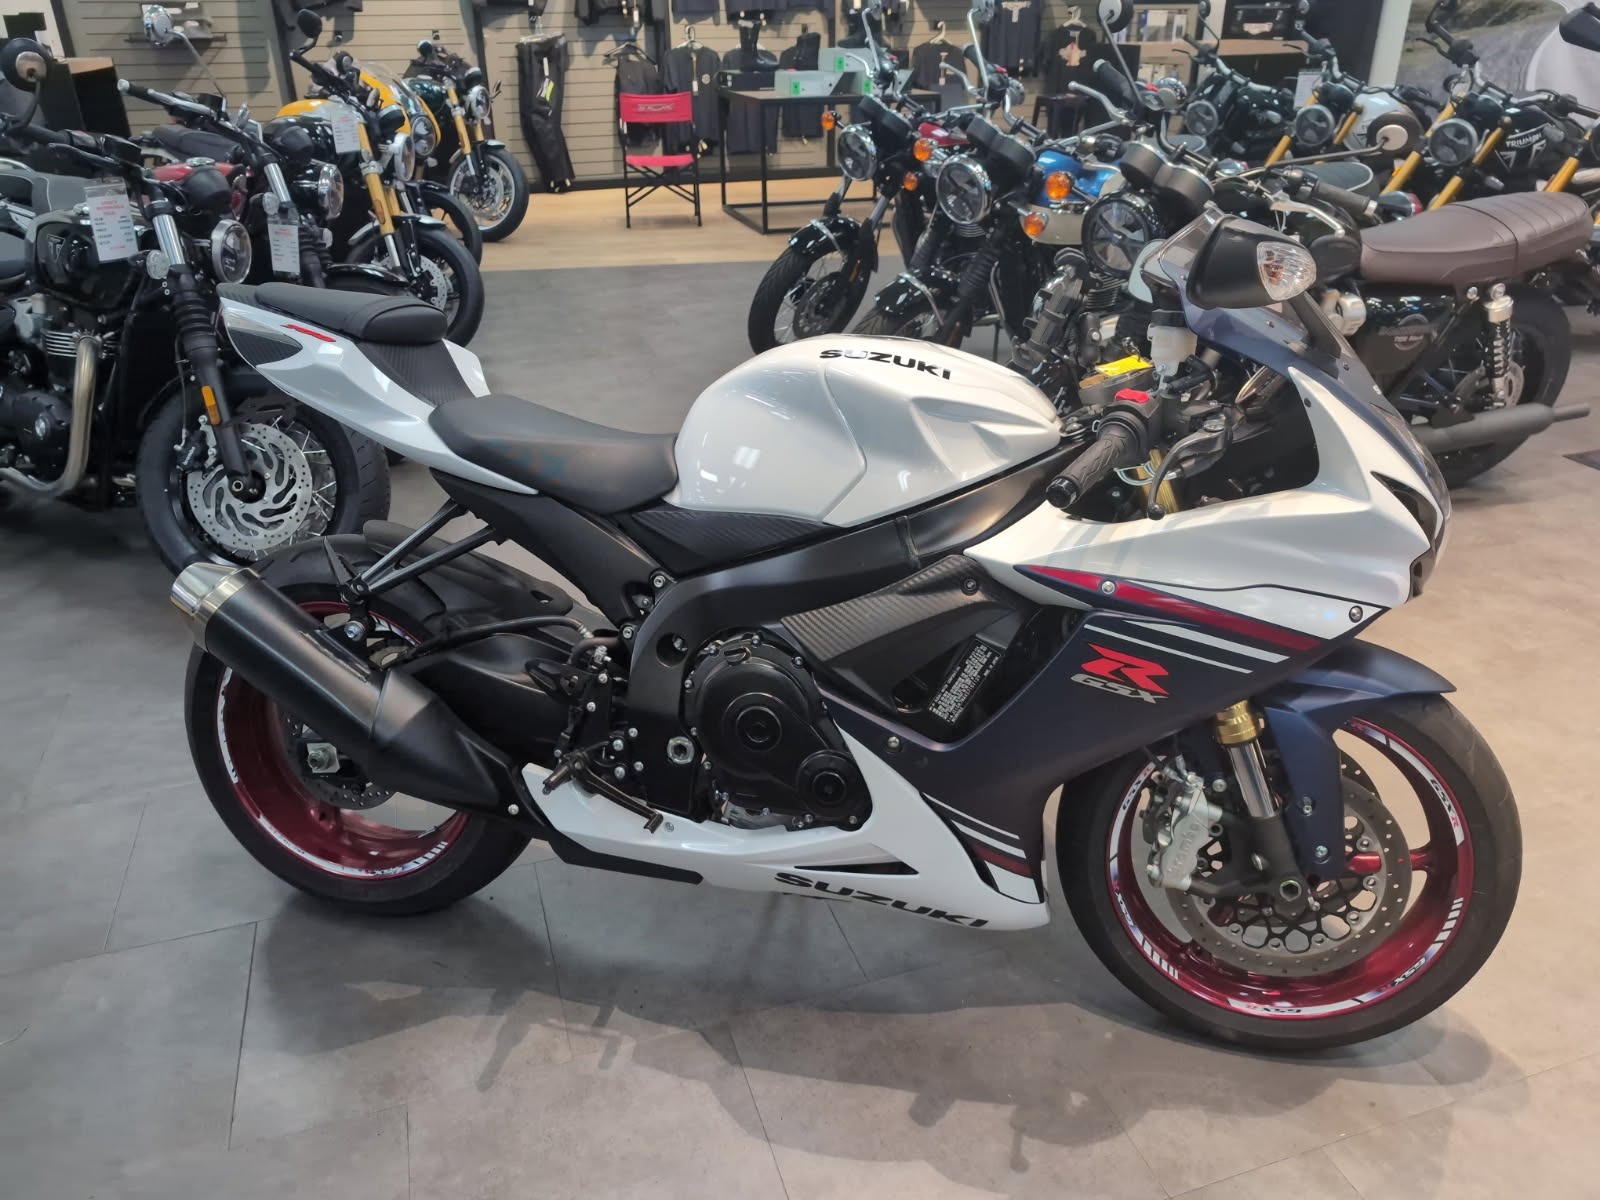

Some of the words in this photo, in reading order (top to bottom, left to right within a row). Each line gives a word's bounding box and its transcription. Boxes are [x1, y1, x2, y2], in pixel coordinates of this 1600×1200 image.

[1505, 132, 1542, 148] TRIUMPH
[819, 349, 951, 380] SUZUKI
[1070, 673, 1168, 704] GSX
[774, 872, 989, 928] SUZUKI
